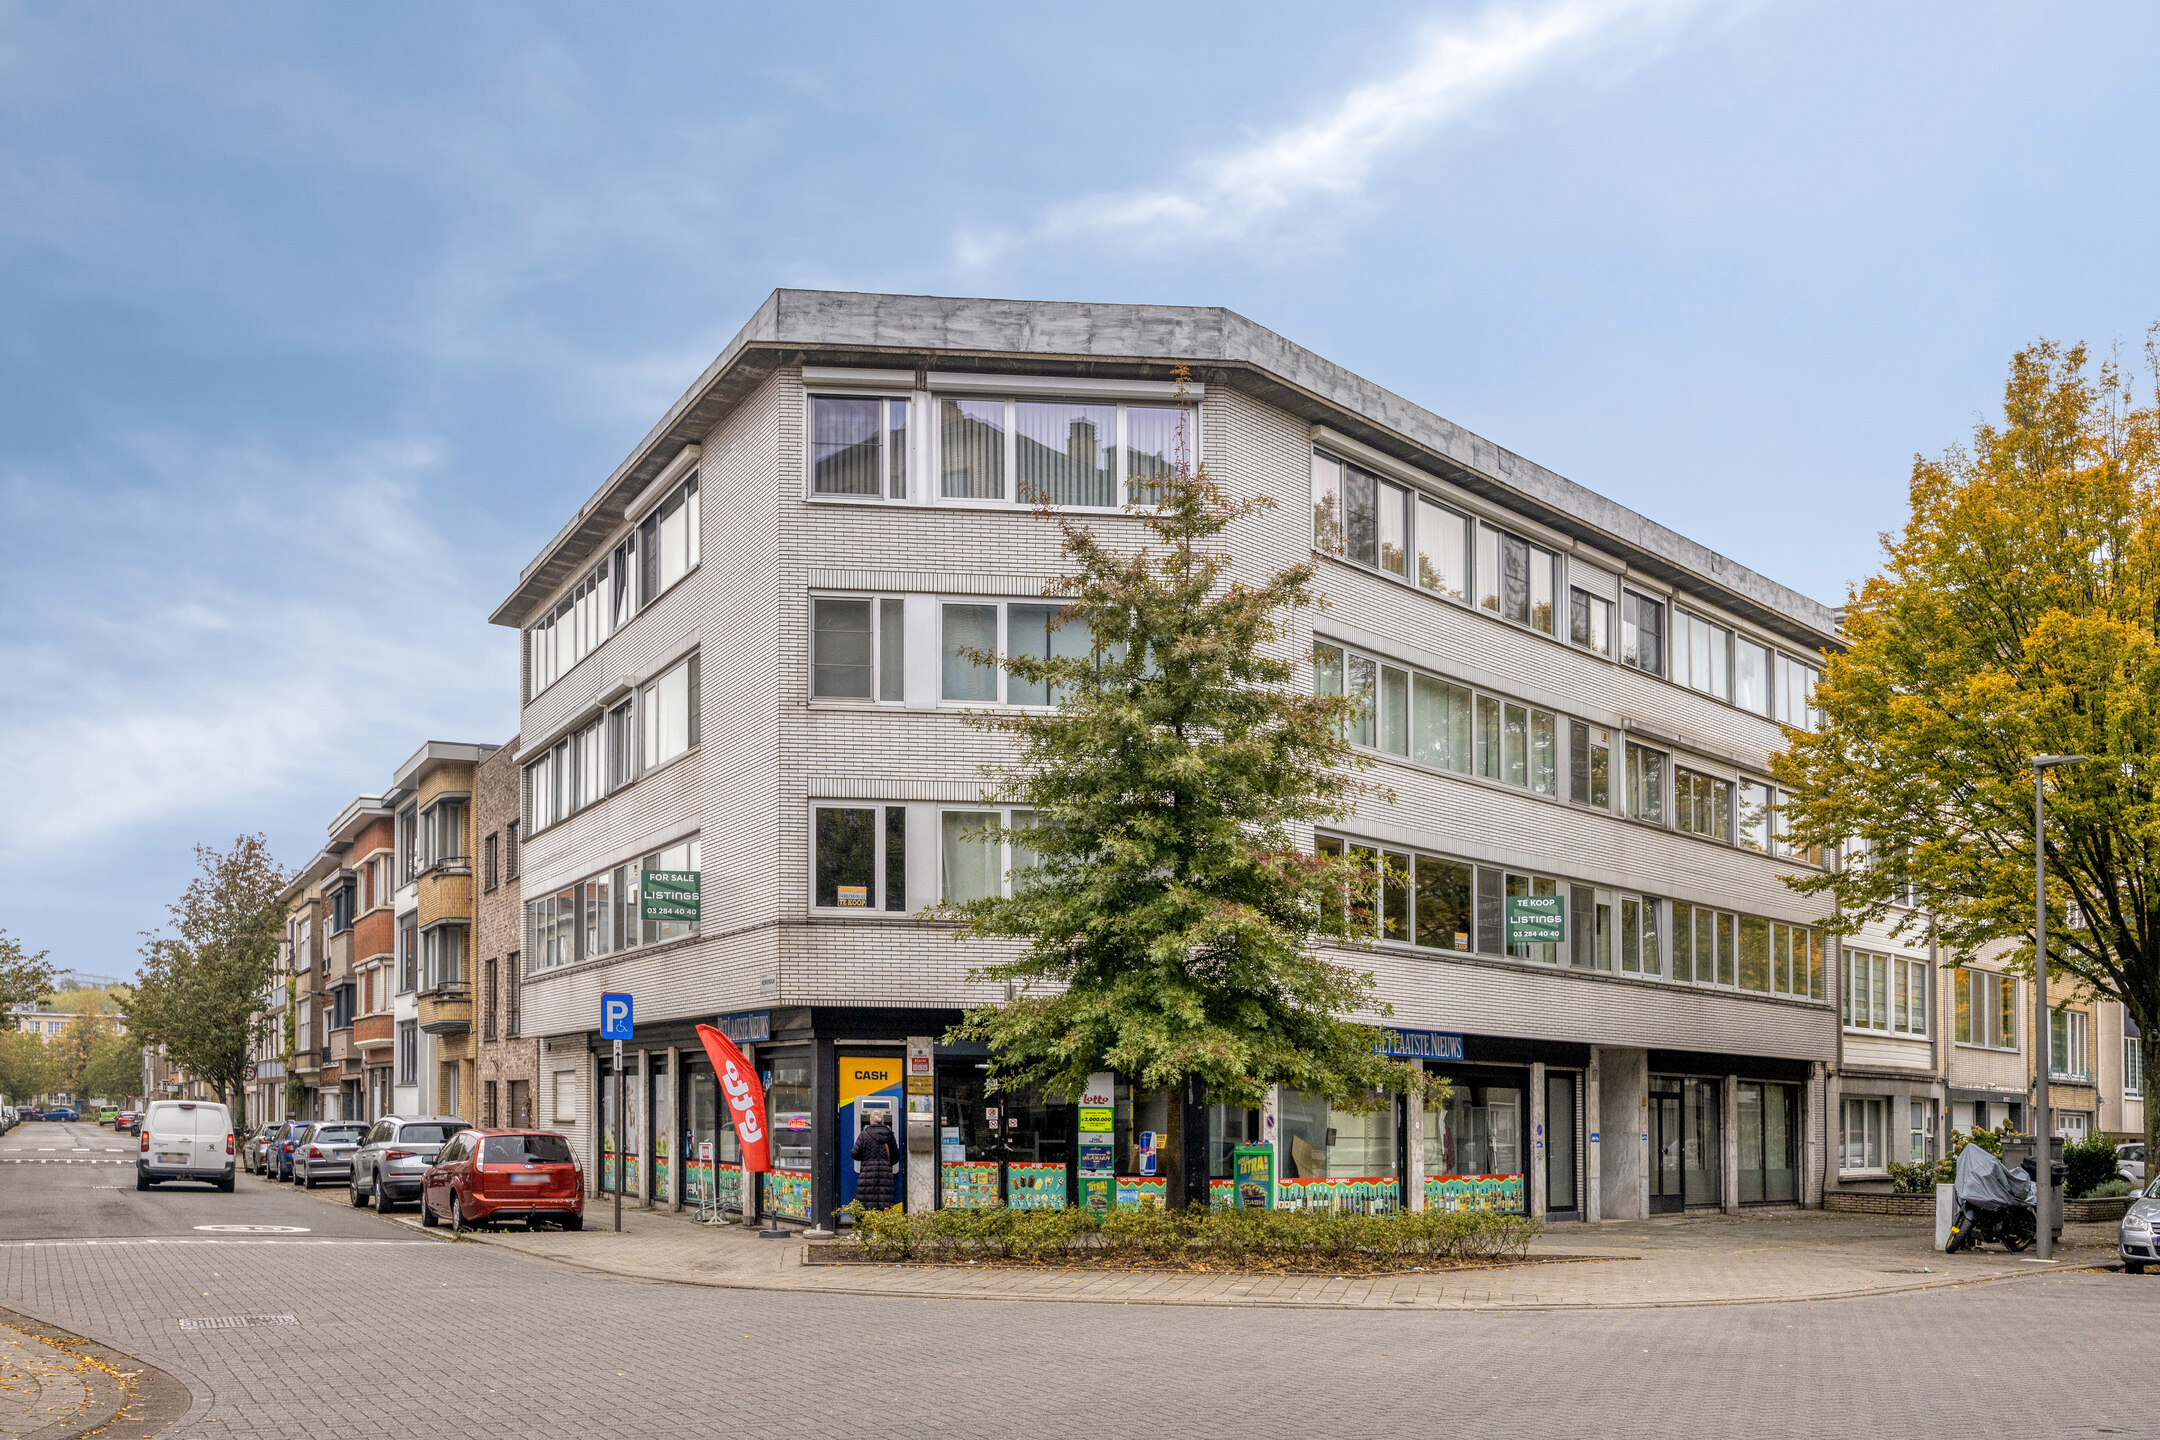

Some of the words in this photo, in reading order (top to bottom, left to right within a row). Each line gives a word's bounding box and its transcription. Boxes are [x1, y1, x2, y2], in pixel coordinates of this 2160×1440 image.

[644, 891, 700, 900] LISTINGS
[1510, 916, 1562, 924] LISTINGS
[606, 1001, 628, 1032] P
[728, 1016, 748, 1040] LAATSTE
[749, 1014, 769, 1039] NIEUWS
[1430, 1032, 1462, 1058] NIEUWS
[854, 1070, 888, 1080] CASH
[1240, 1155, 1269, 1174] EXTRA!
